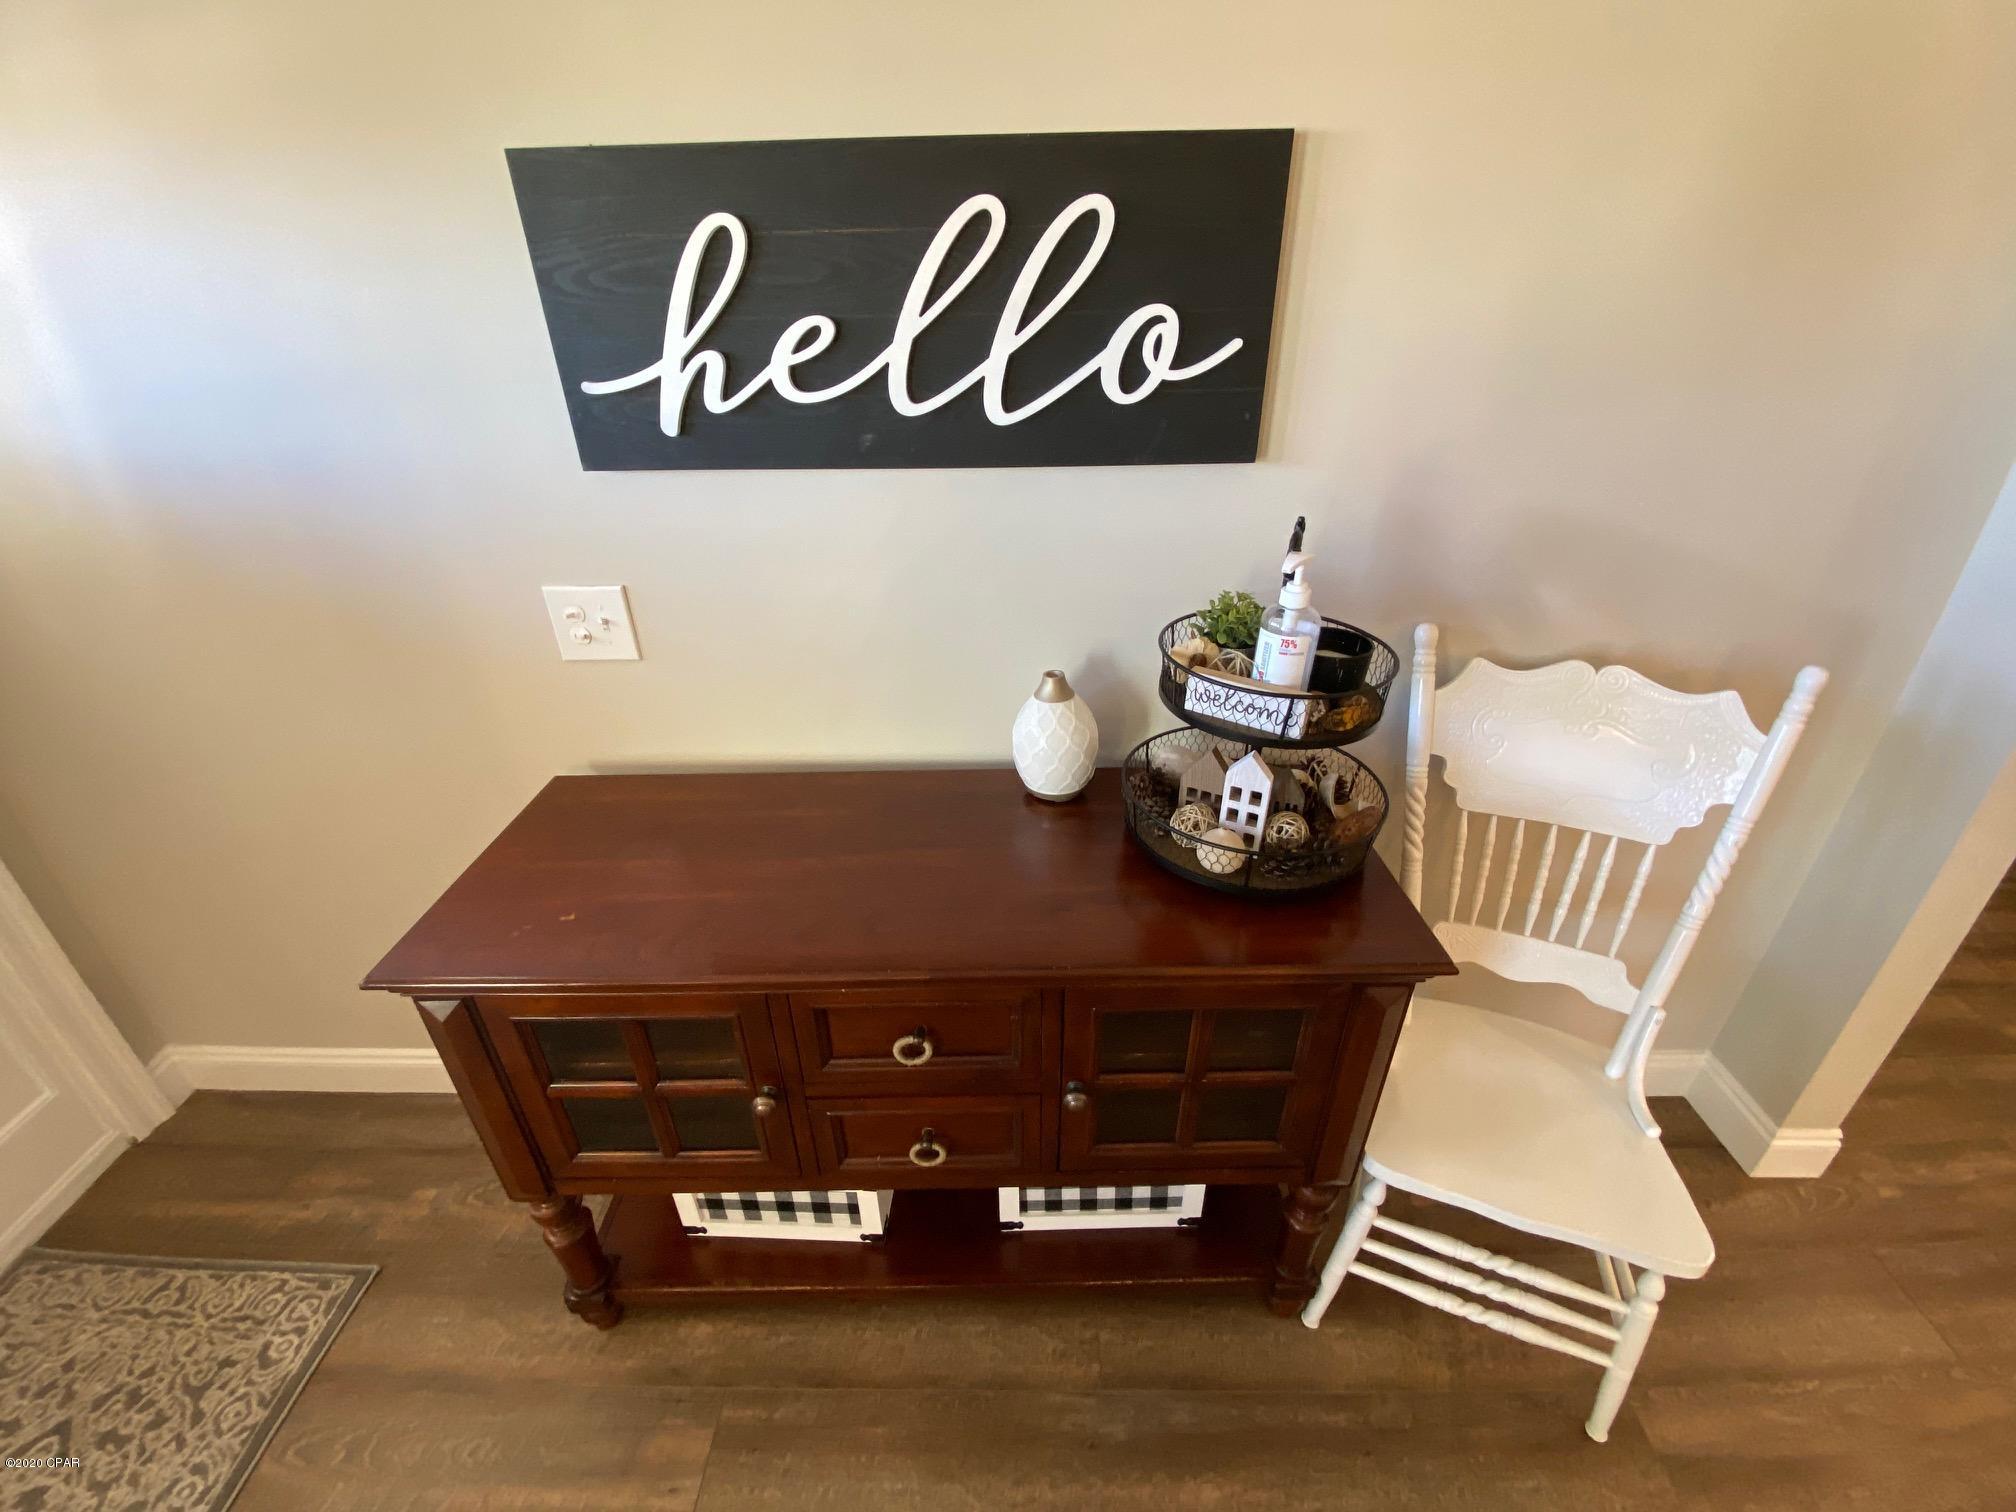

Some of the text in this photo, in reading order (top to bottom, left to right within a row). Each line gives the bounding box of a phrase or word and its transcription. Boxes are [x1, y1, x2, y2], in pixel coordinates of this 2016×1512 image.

[581, 193, 1244, 437] hello
[1280, 638, 1298, 649] 75%
[1194, 688, 1299, 727] welcome
